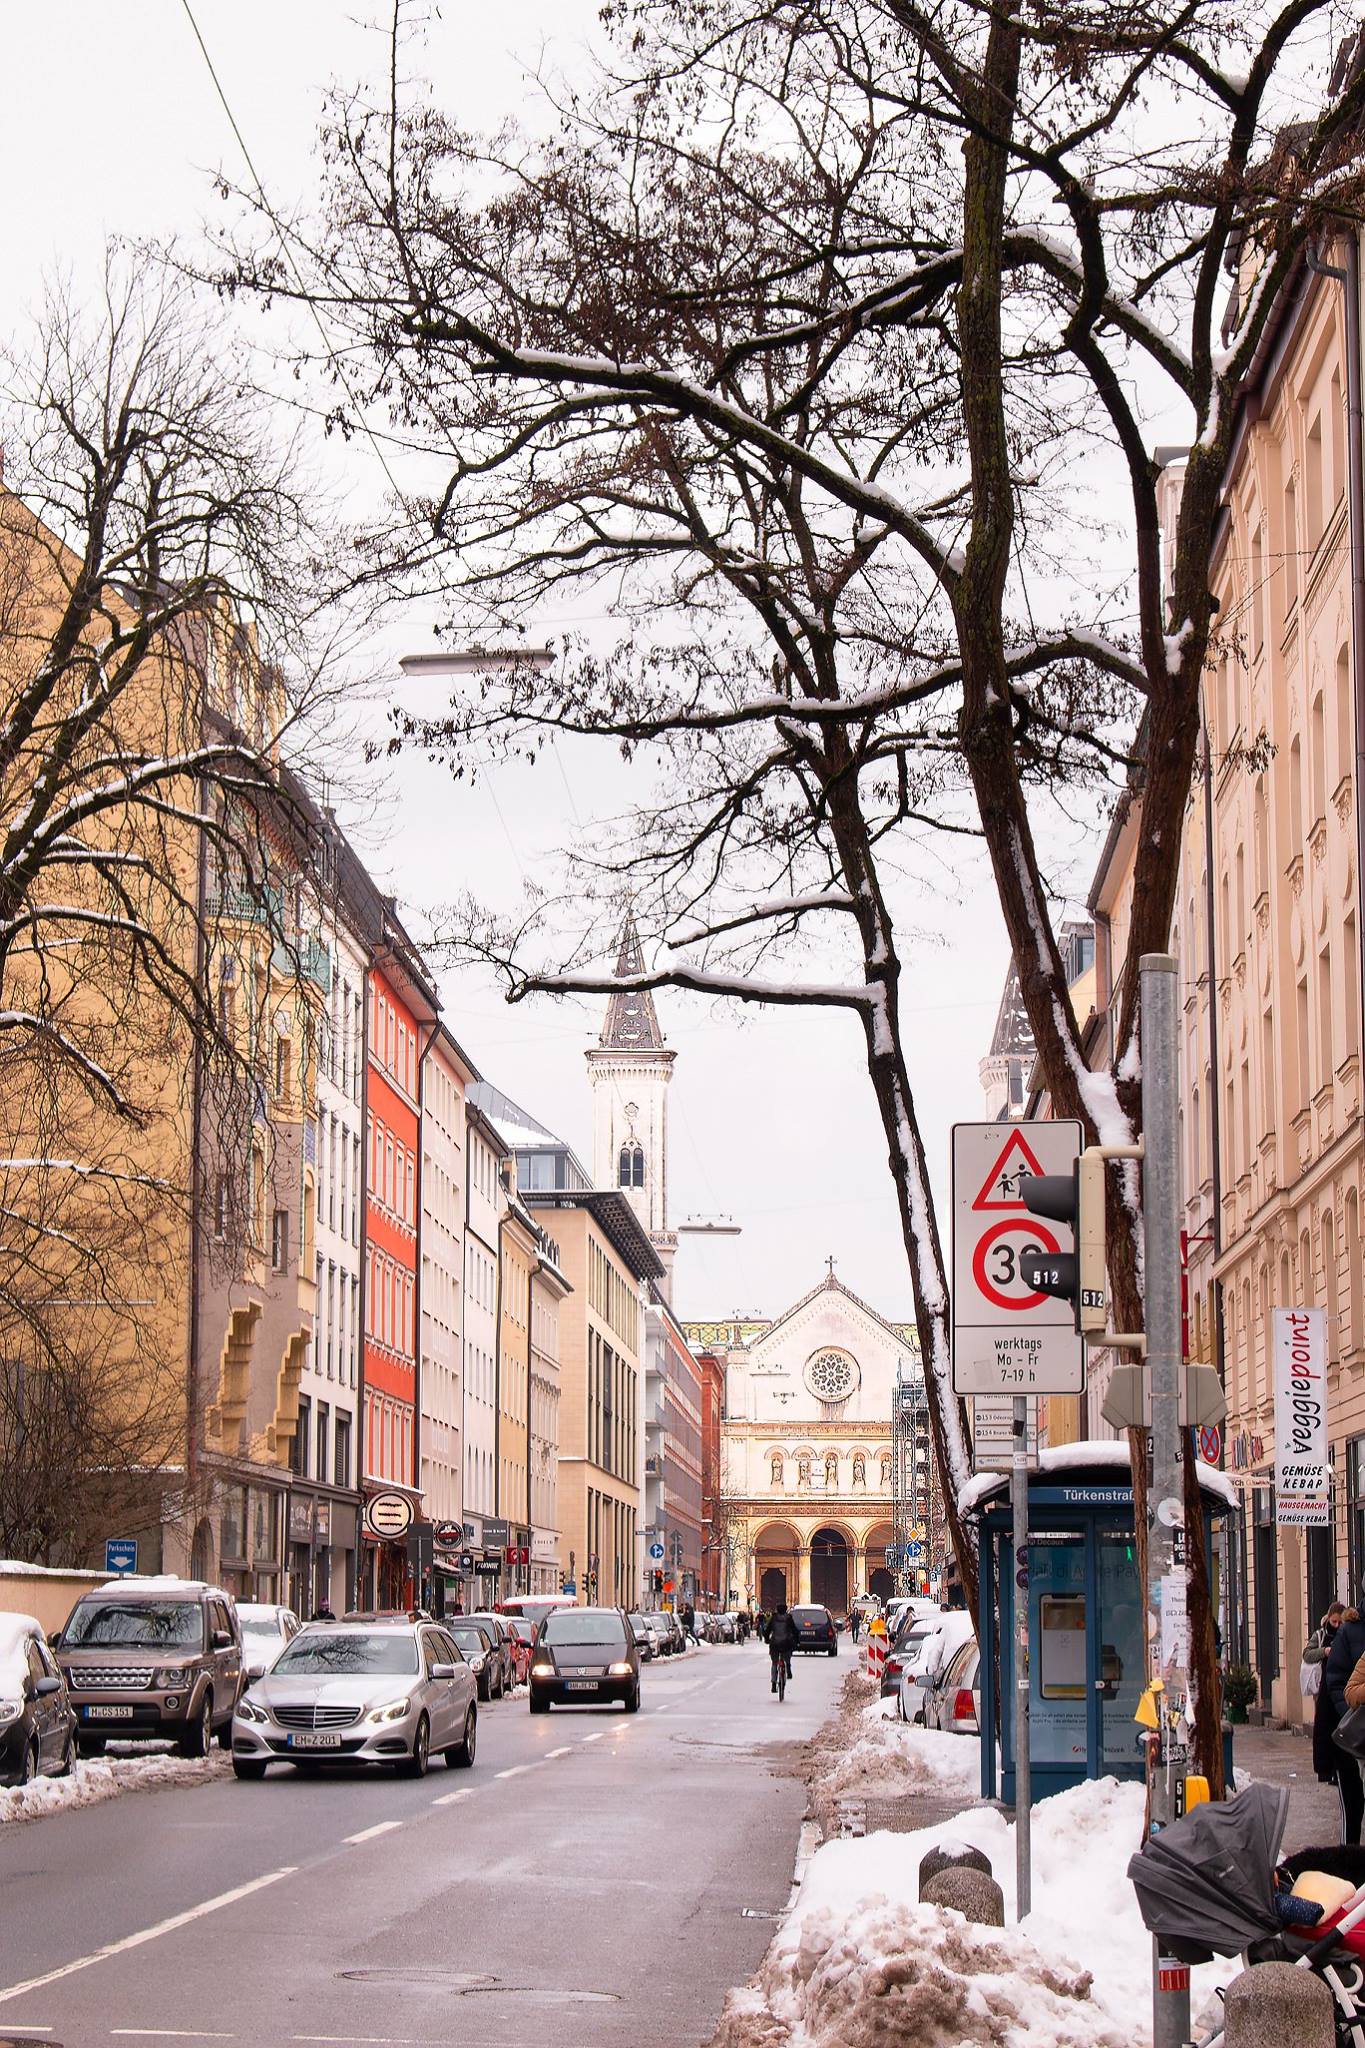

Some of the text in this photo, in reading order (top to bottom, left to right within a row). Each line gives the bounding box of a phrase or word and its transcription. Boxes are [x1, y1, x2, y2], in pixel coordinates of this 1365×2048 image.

[992, 1244, 1042, 1285] 3
[1033, 1271, 1059, 1285] 512
[1083, 1291, 1103, 1306] 512
[994, 1337, 1042, 1351] werktags
[997, 1353, 1012, 1366] Mo
[1028, 1353, 1039, 1366] Fr
[1001, 1369, 1036, 1382] 7-19 h
[1281, 1463, 1324, 1476] GEMÜSE
[1283, 1478, 1323, 1489] KEBAP
[1278, 1501, 1327, 1510] HAUSGEMACHT
[1278, 1513, 1327, 1523] GEMÜSE KEBAP
[91, 1706, 130, 1717] M CS 151
[294, 1734, 337, 1746] EM Z 201
